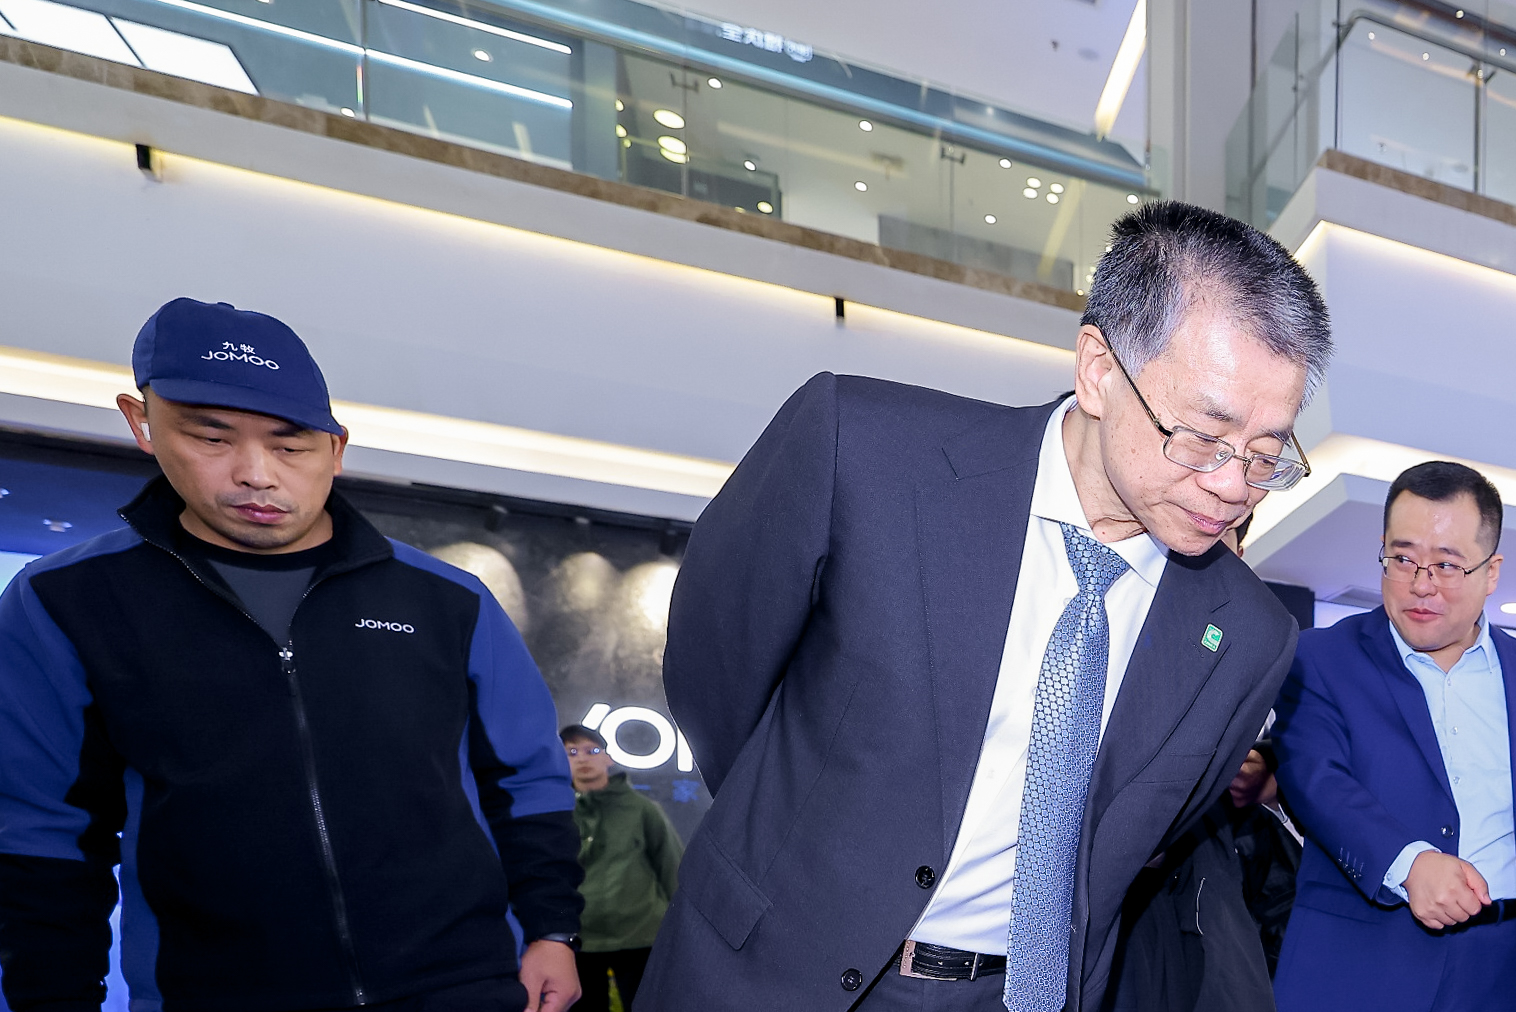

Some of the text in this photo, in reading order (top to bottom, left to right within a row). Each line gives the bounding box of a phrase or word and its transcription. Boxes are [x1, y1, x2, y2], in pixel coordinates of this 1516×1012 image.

[222, 341, 256, 355] 九牧
[200, 350, 280, 370] JOMOO
[354, 618, 415, 634] JOMOO
